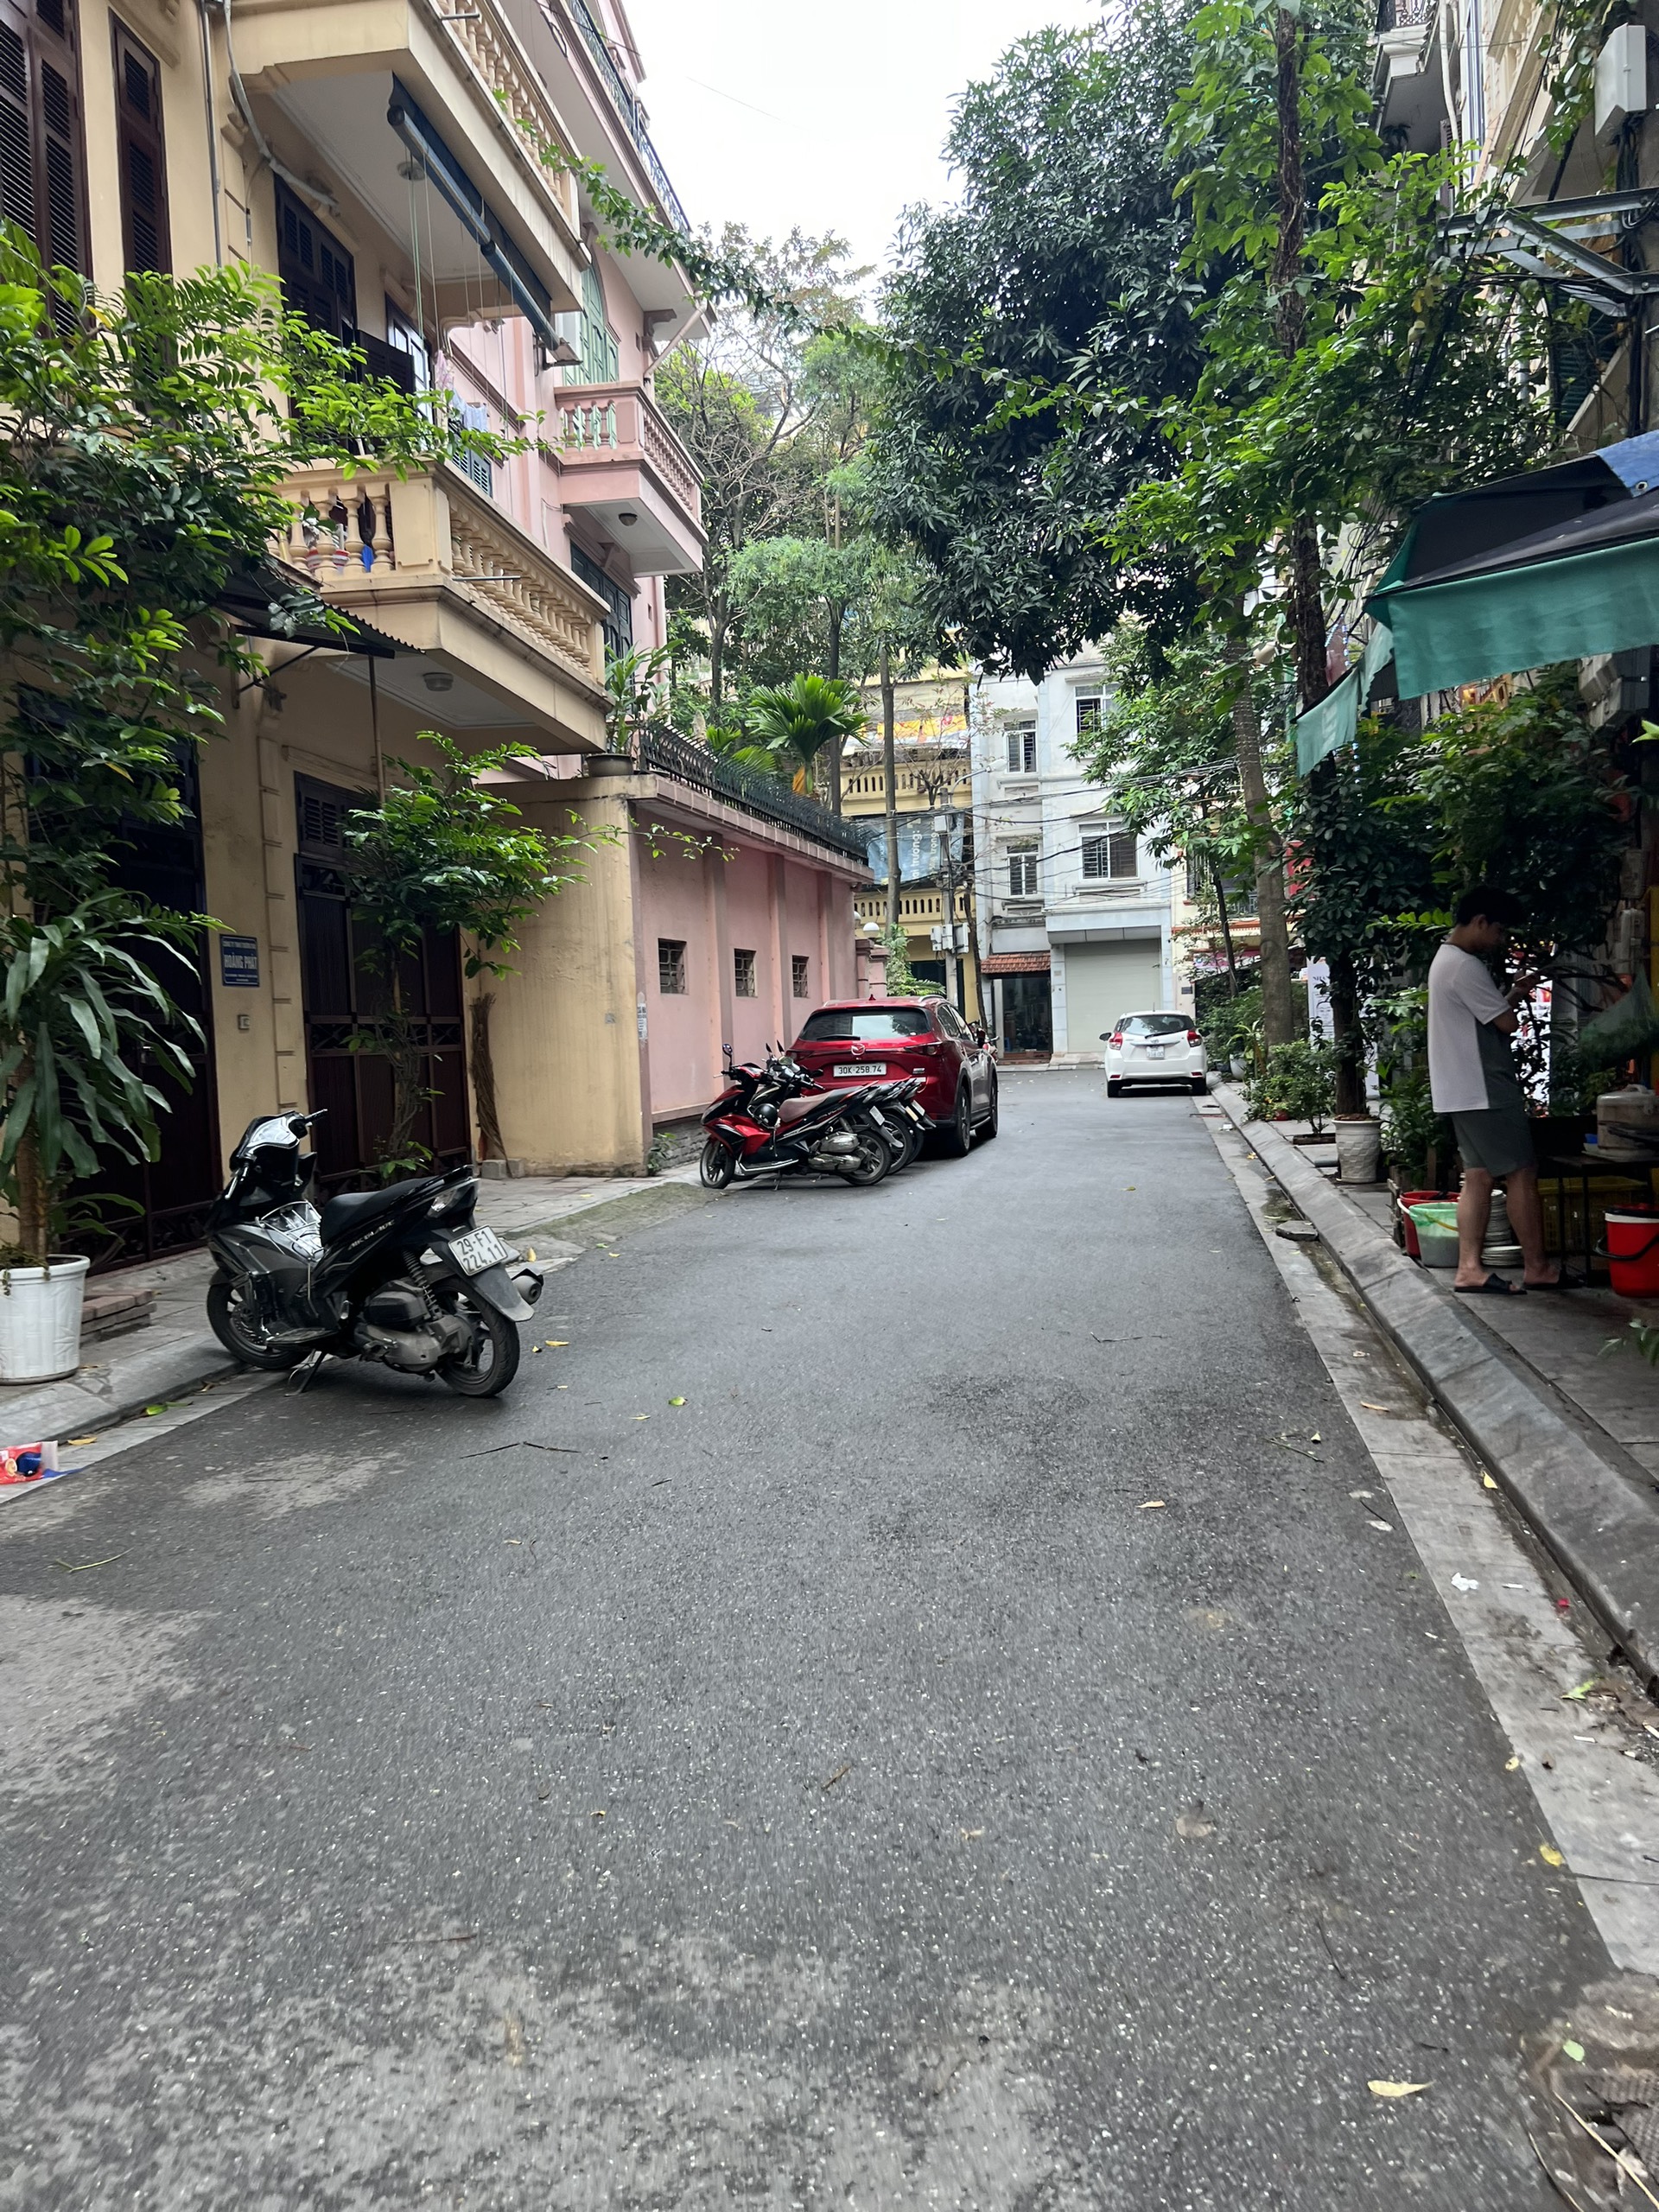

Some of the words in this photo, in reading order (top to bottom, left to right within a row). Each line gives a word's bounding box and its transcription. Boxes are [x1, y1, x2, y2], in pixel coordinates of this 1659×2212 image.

[223, 952, 244, 969] HOÀNG
[244, 953, 257, 969] PHÁT
[838, 1065, 881, 1075] 30K-258.74
[457, 1230, 492, 1255] 29-F1
[463, 1243, 504, 1272] 224.11
